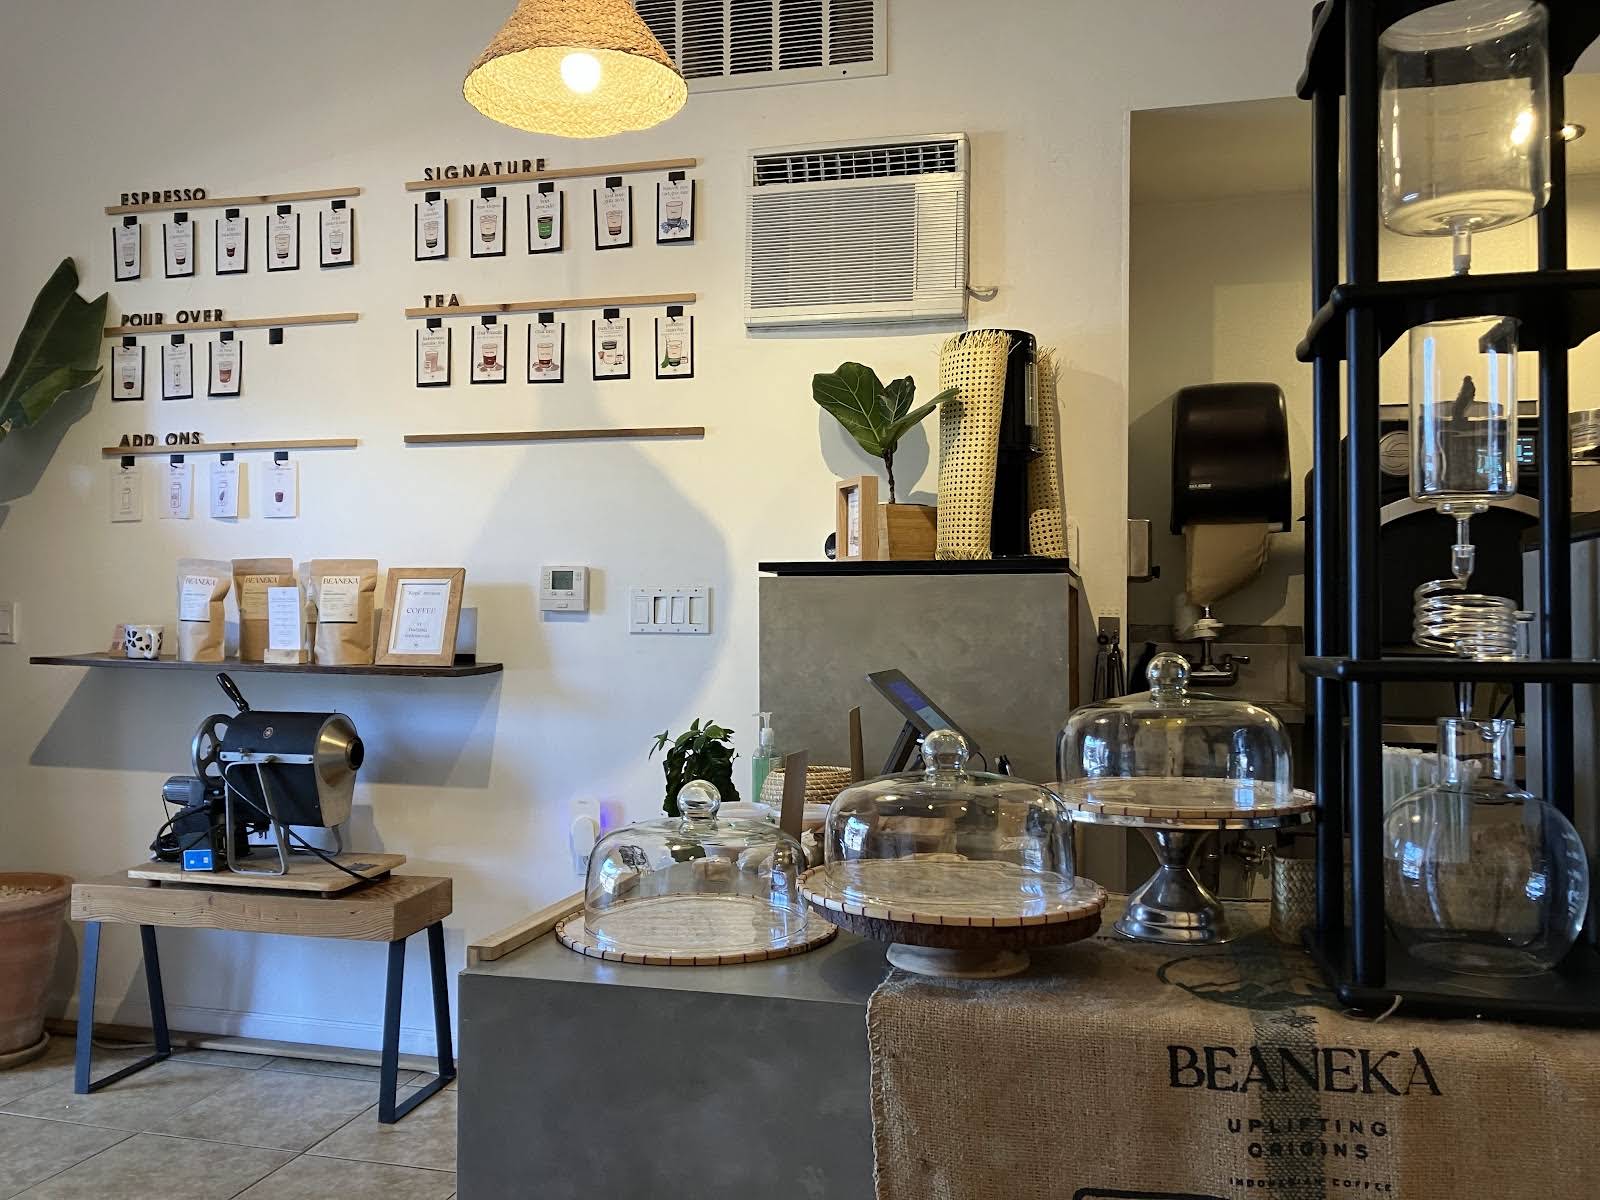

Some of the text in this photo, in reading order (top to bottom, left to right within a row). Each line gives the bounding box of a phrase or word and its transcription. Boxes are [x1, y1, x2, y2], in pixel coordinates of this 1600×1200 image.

[424, 159, 545, 181] SIGNATURE
[121, 188, 206, 206] ESPRESSO
[423, 294, 460, 308] TEA
[121, 309, 223, 327] POUR OVER
[119, 431, 200, 447] ADD ONS
[322, 577, 359, 585] BEANEKA
[1167, 1046, 1442, 1096] BEANEKA
[1228, 1118, 1388, 1137] UPLIFTING
[1248, 1142, 1369, 1160] ORIGINS
